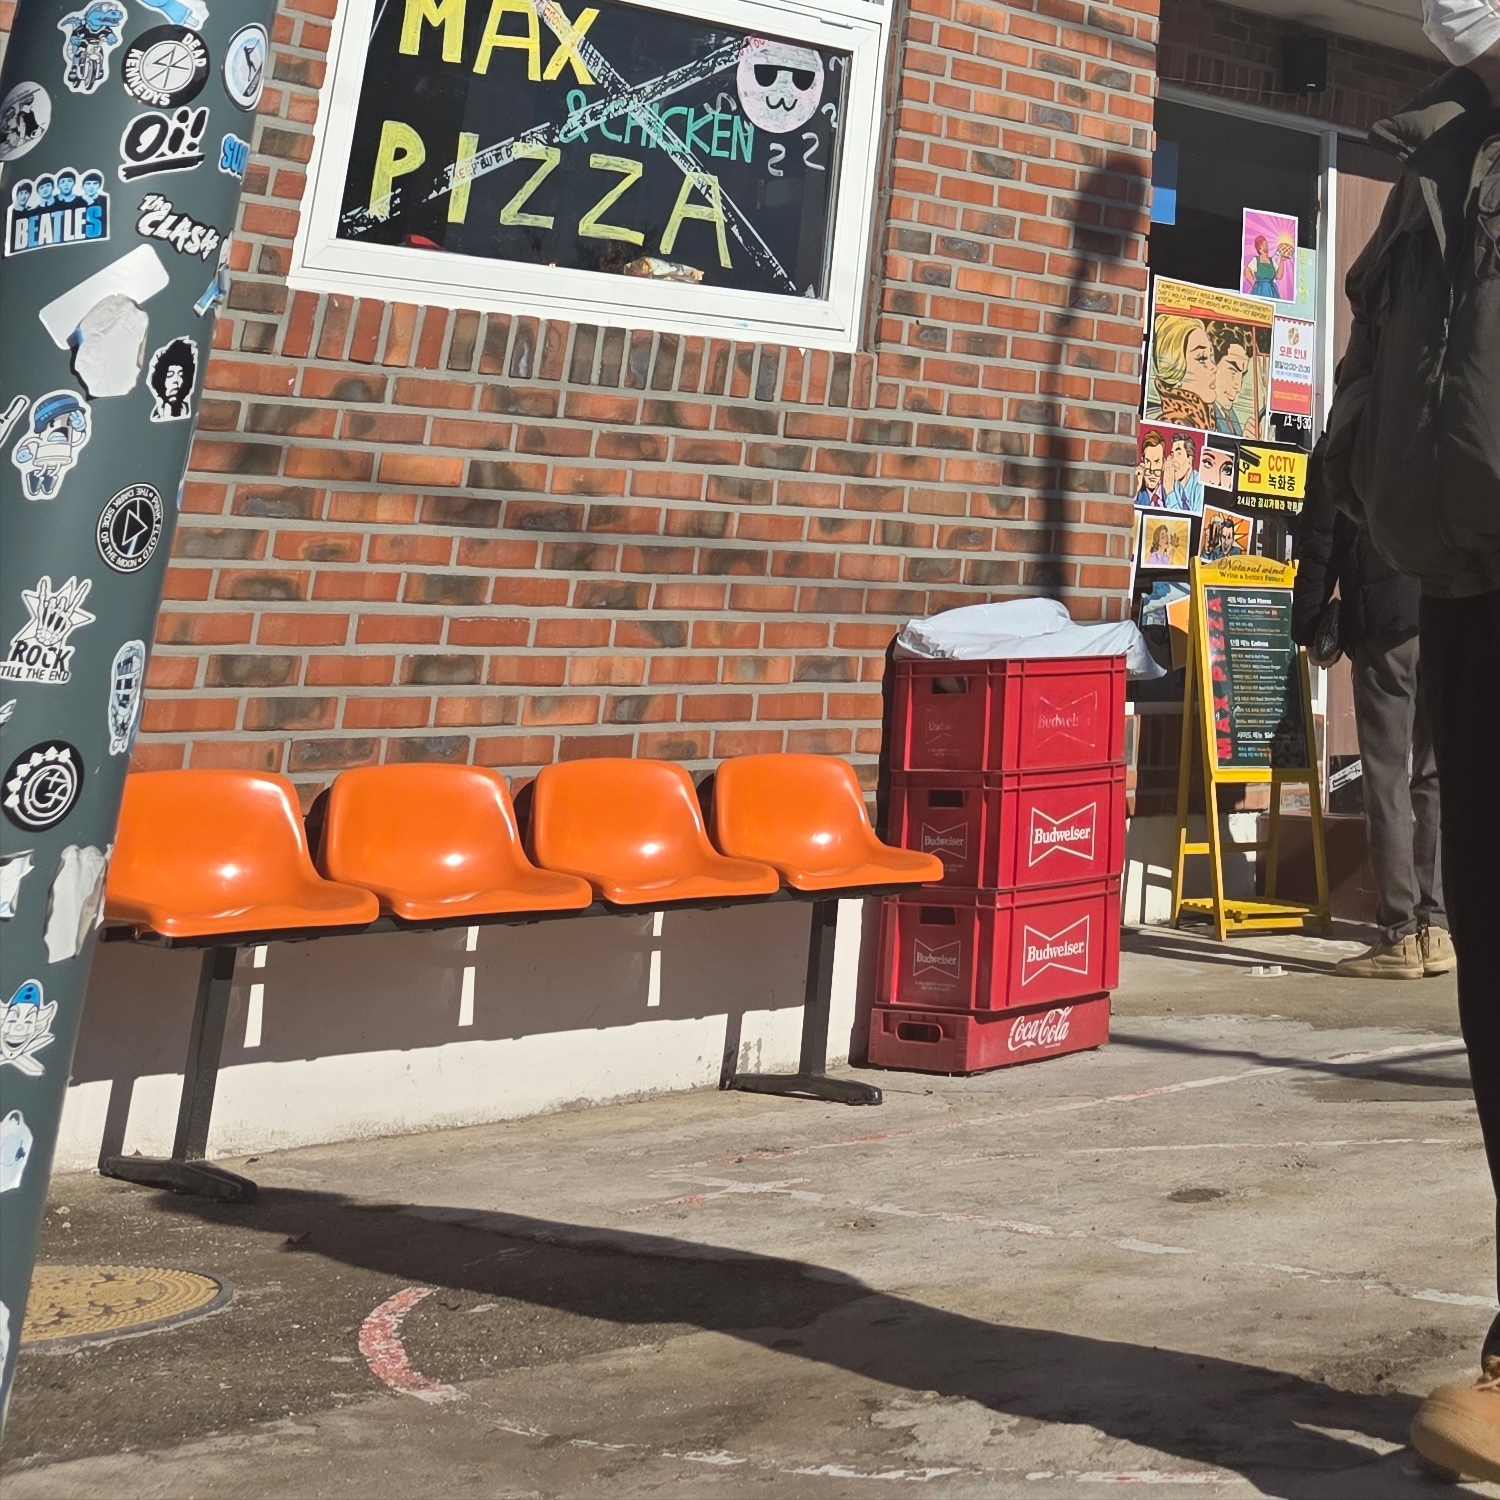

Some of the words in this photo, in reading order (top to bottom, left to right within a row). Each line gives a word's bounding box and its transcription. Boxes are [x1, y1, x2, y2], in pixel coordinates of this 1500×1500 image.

[181, 32, 207, 68] DEAD
[125, 48, 171, 106] KENNEDYS
[125, 109, 207, 162] Oi!
[369, 120, 734, 269] PIZZA
[15, 206, 103, 250] BEATLES
[1278, 345, 1292, 358] 오픈
[1268, 454, 1296, 473] CCTV
[136, 487, 150, 497] THE
[1268, 474, 1296, 492] 녹화중
[1237, 495, 1256, 508] 24시간
[101, 507, 116, 528] SIDE
[101, 531, 110, 544] OF
[142, 523, 161, 560] FLOYD
[104, 544, 118, 562] THE
[115, 556, 138, 568] MOON
[1218, 559, 1261, 574] Natural
[1261, 565, 1286, 576] wind
[10, 640, 71, 673] ROCK
[25, 666, 45, 681] THE
[48, 668, 71, 683] END
[924, 835, 964, 847] Budweiser
[1034, 825, 1090, 845] Budweiser
[916, 953, 957, 965] Budweiser
[1027, 940, 1085, 963] Budweiser
